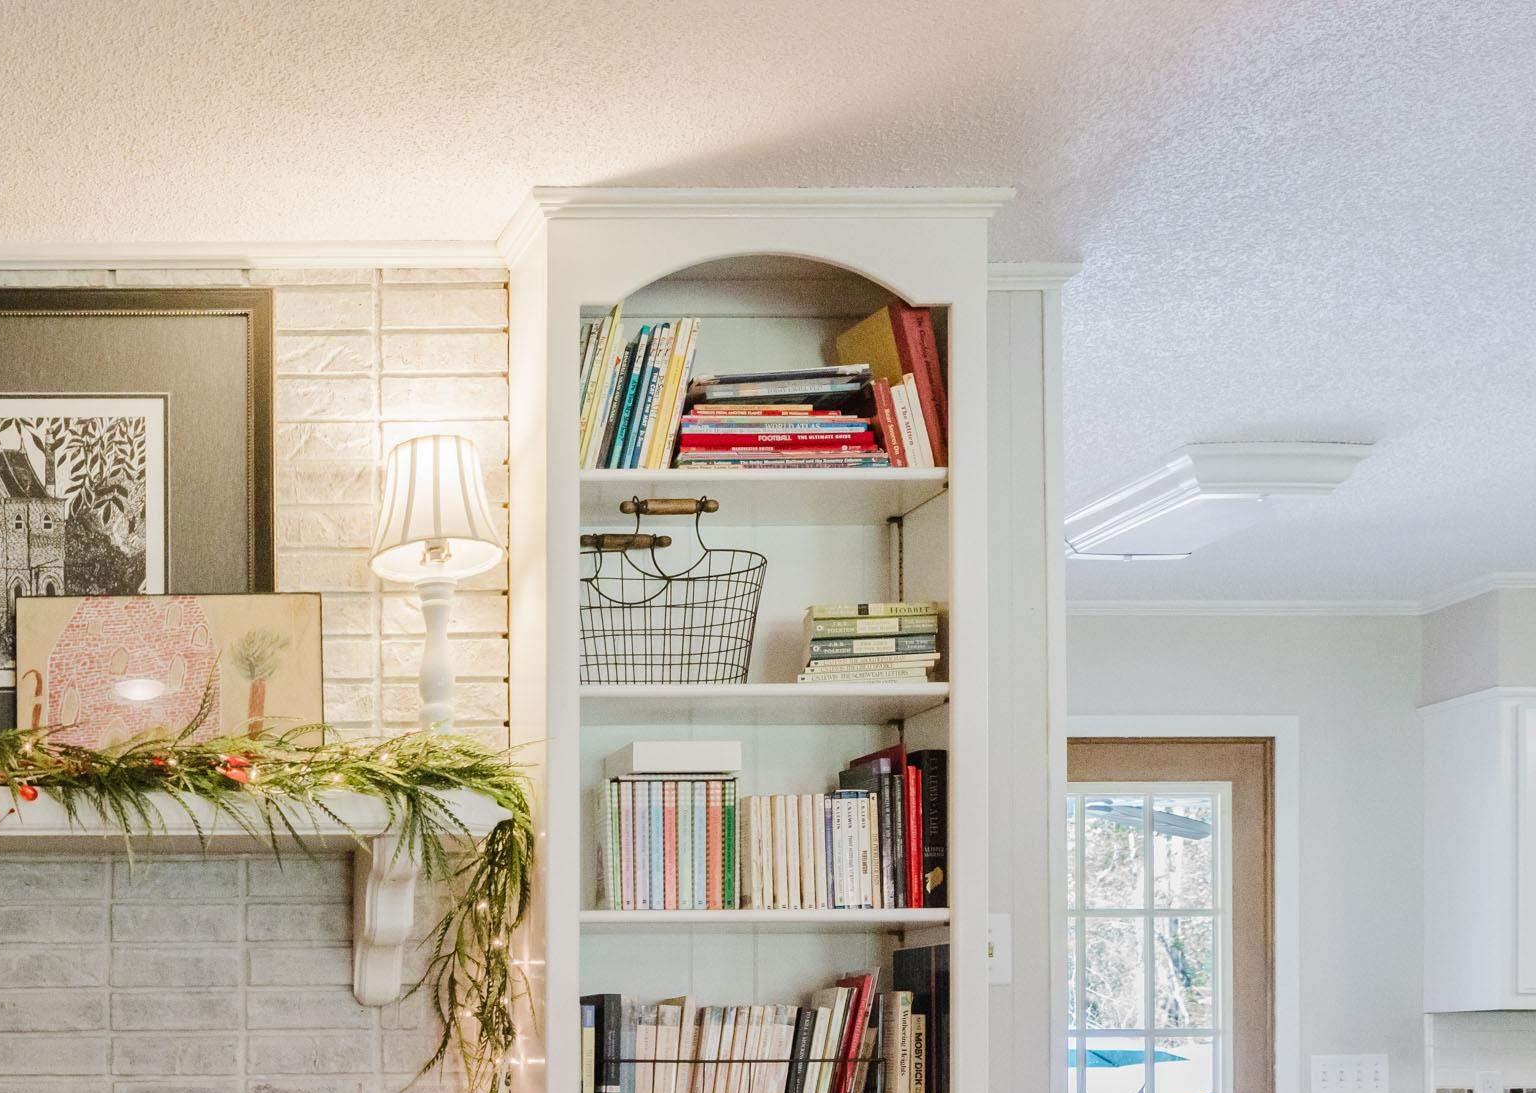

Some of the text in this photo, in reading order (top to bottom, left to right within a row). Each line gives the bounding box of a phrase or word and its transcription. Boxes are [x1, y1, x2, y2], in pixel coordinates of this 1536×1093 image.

[797, 1037, 808, 1074] MOCKINBIRD
[899, 1010, 909, 1076] Wuthering Heights
[914, 1032, 923, 1087] MOBY DICK
